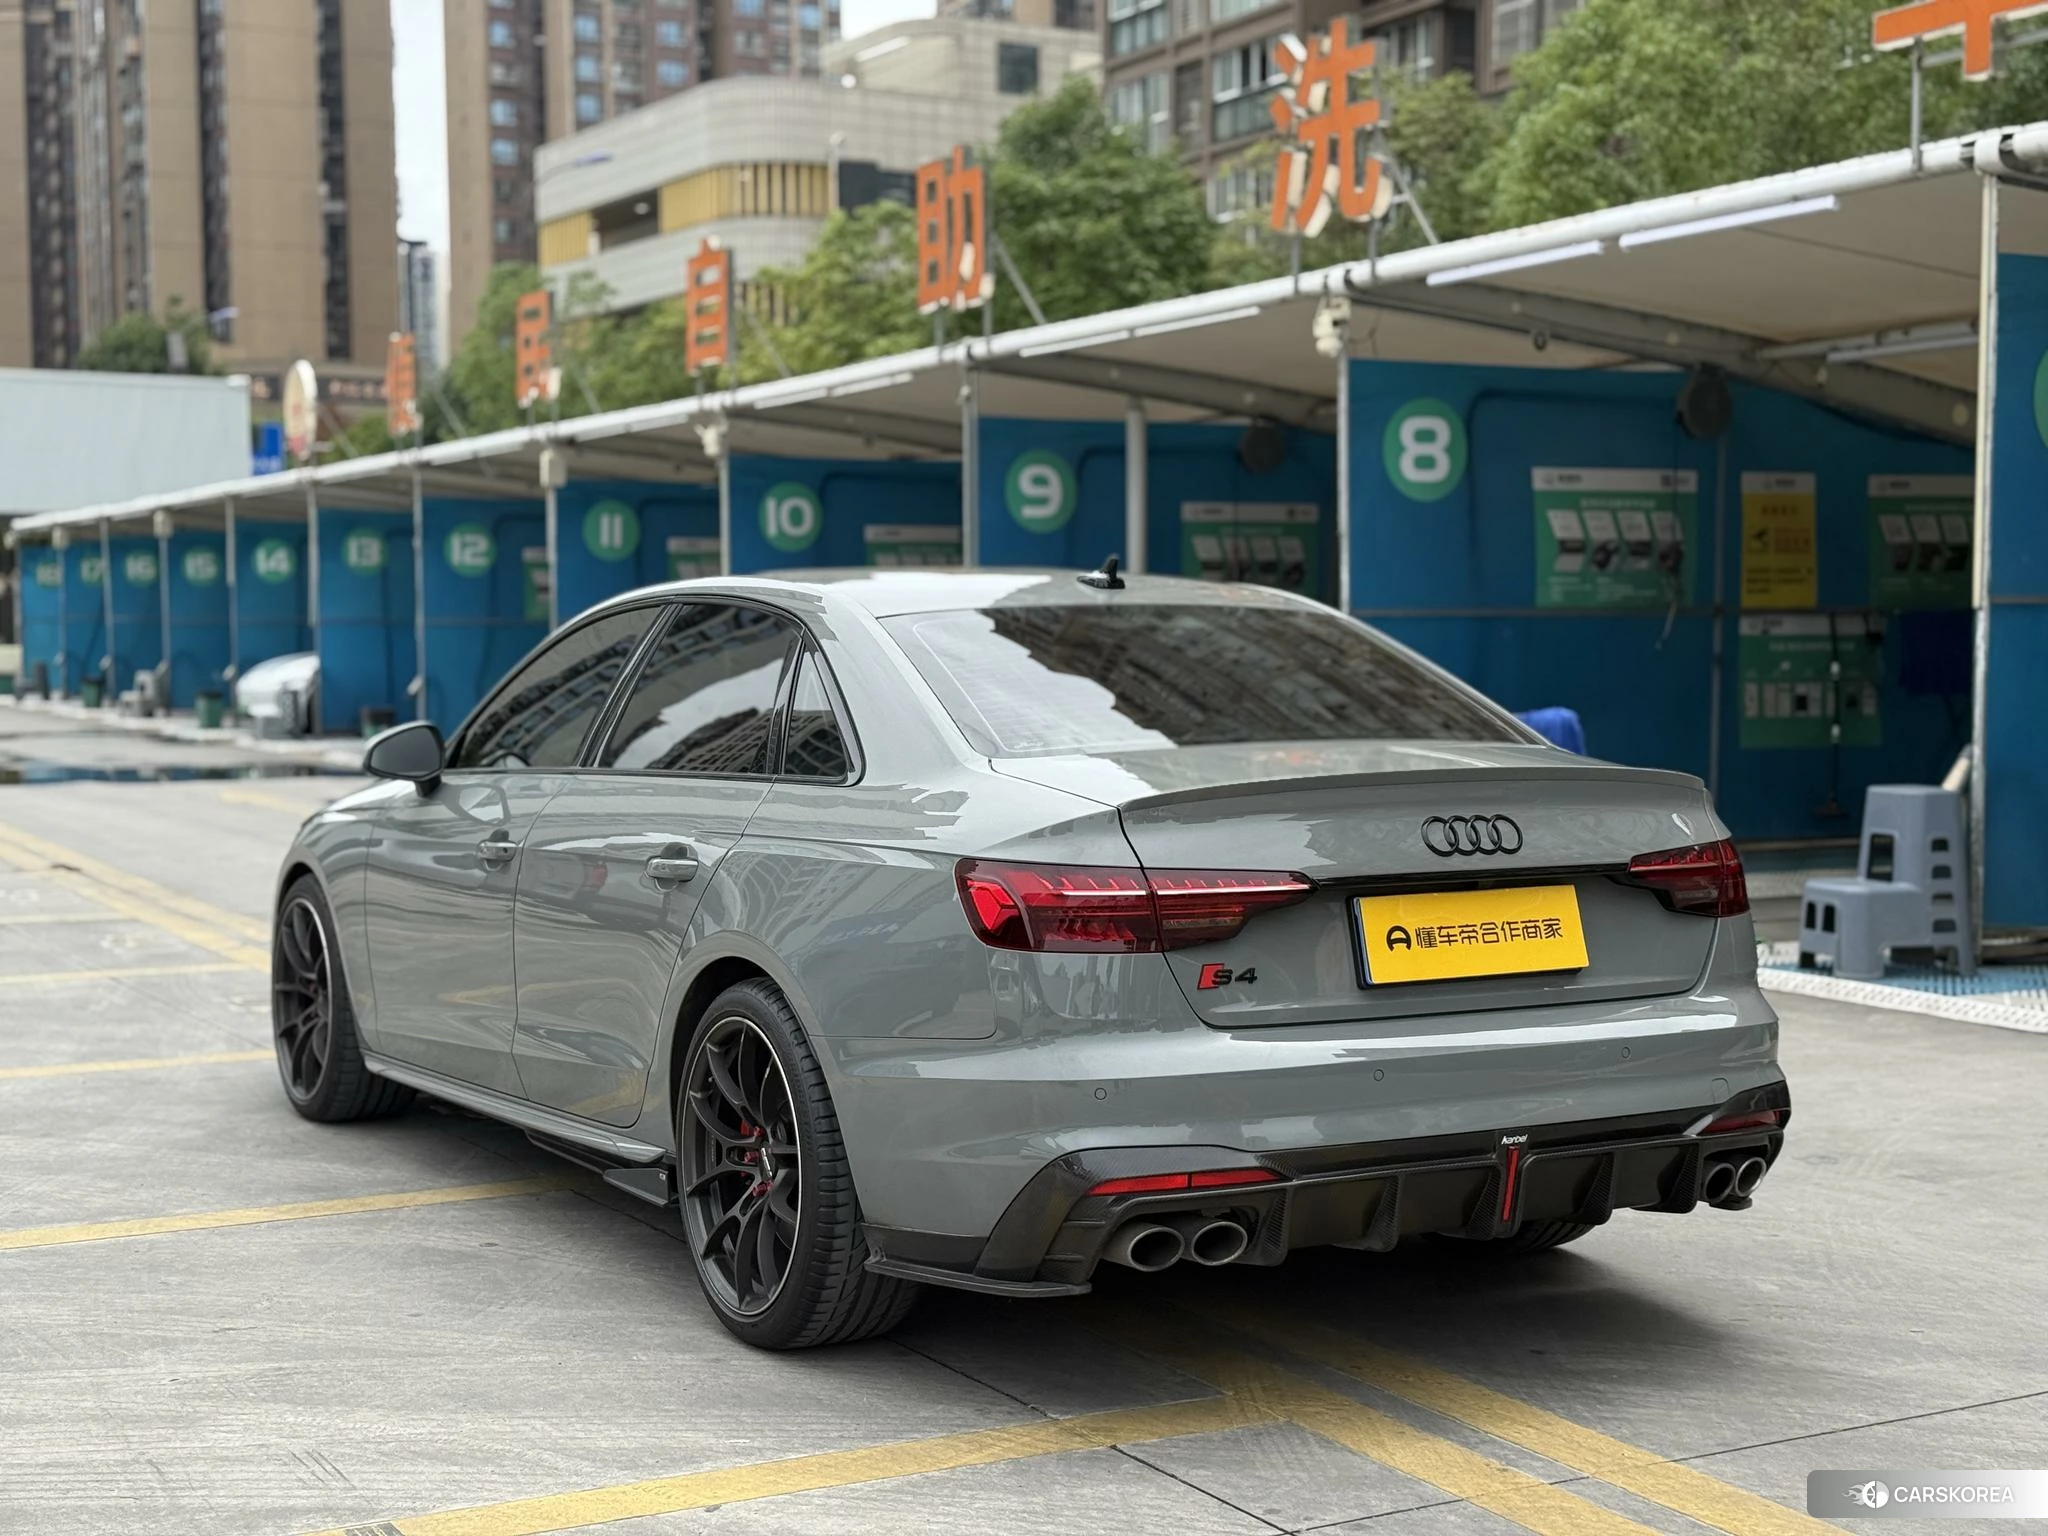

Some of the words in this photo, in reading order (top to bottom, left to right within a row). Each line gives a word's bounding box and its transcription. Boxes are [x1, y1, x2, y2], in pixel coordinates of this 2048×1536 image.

[1399, 415, 1451, 483] 8
[1018, 464, 1063, 518] 9
[601, 513, 623, 549] 11
[765, 497, 815, 538] 10
[255, 547, 291, 576] 14
[346, 536, 382, 567] 13
[450, 534, 491, 565] 12
[184, 551, 218, 580] 15
[1414, 917, 1564, 949] 懂车帝合作商家
[1210, 967, 1258, 986] S4
[1501, 1133, 1529, 1145] karbel
